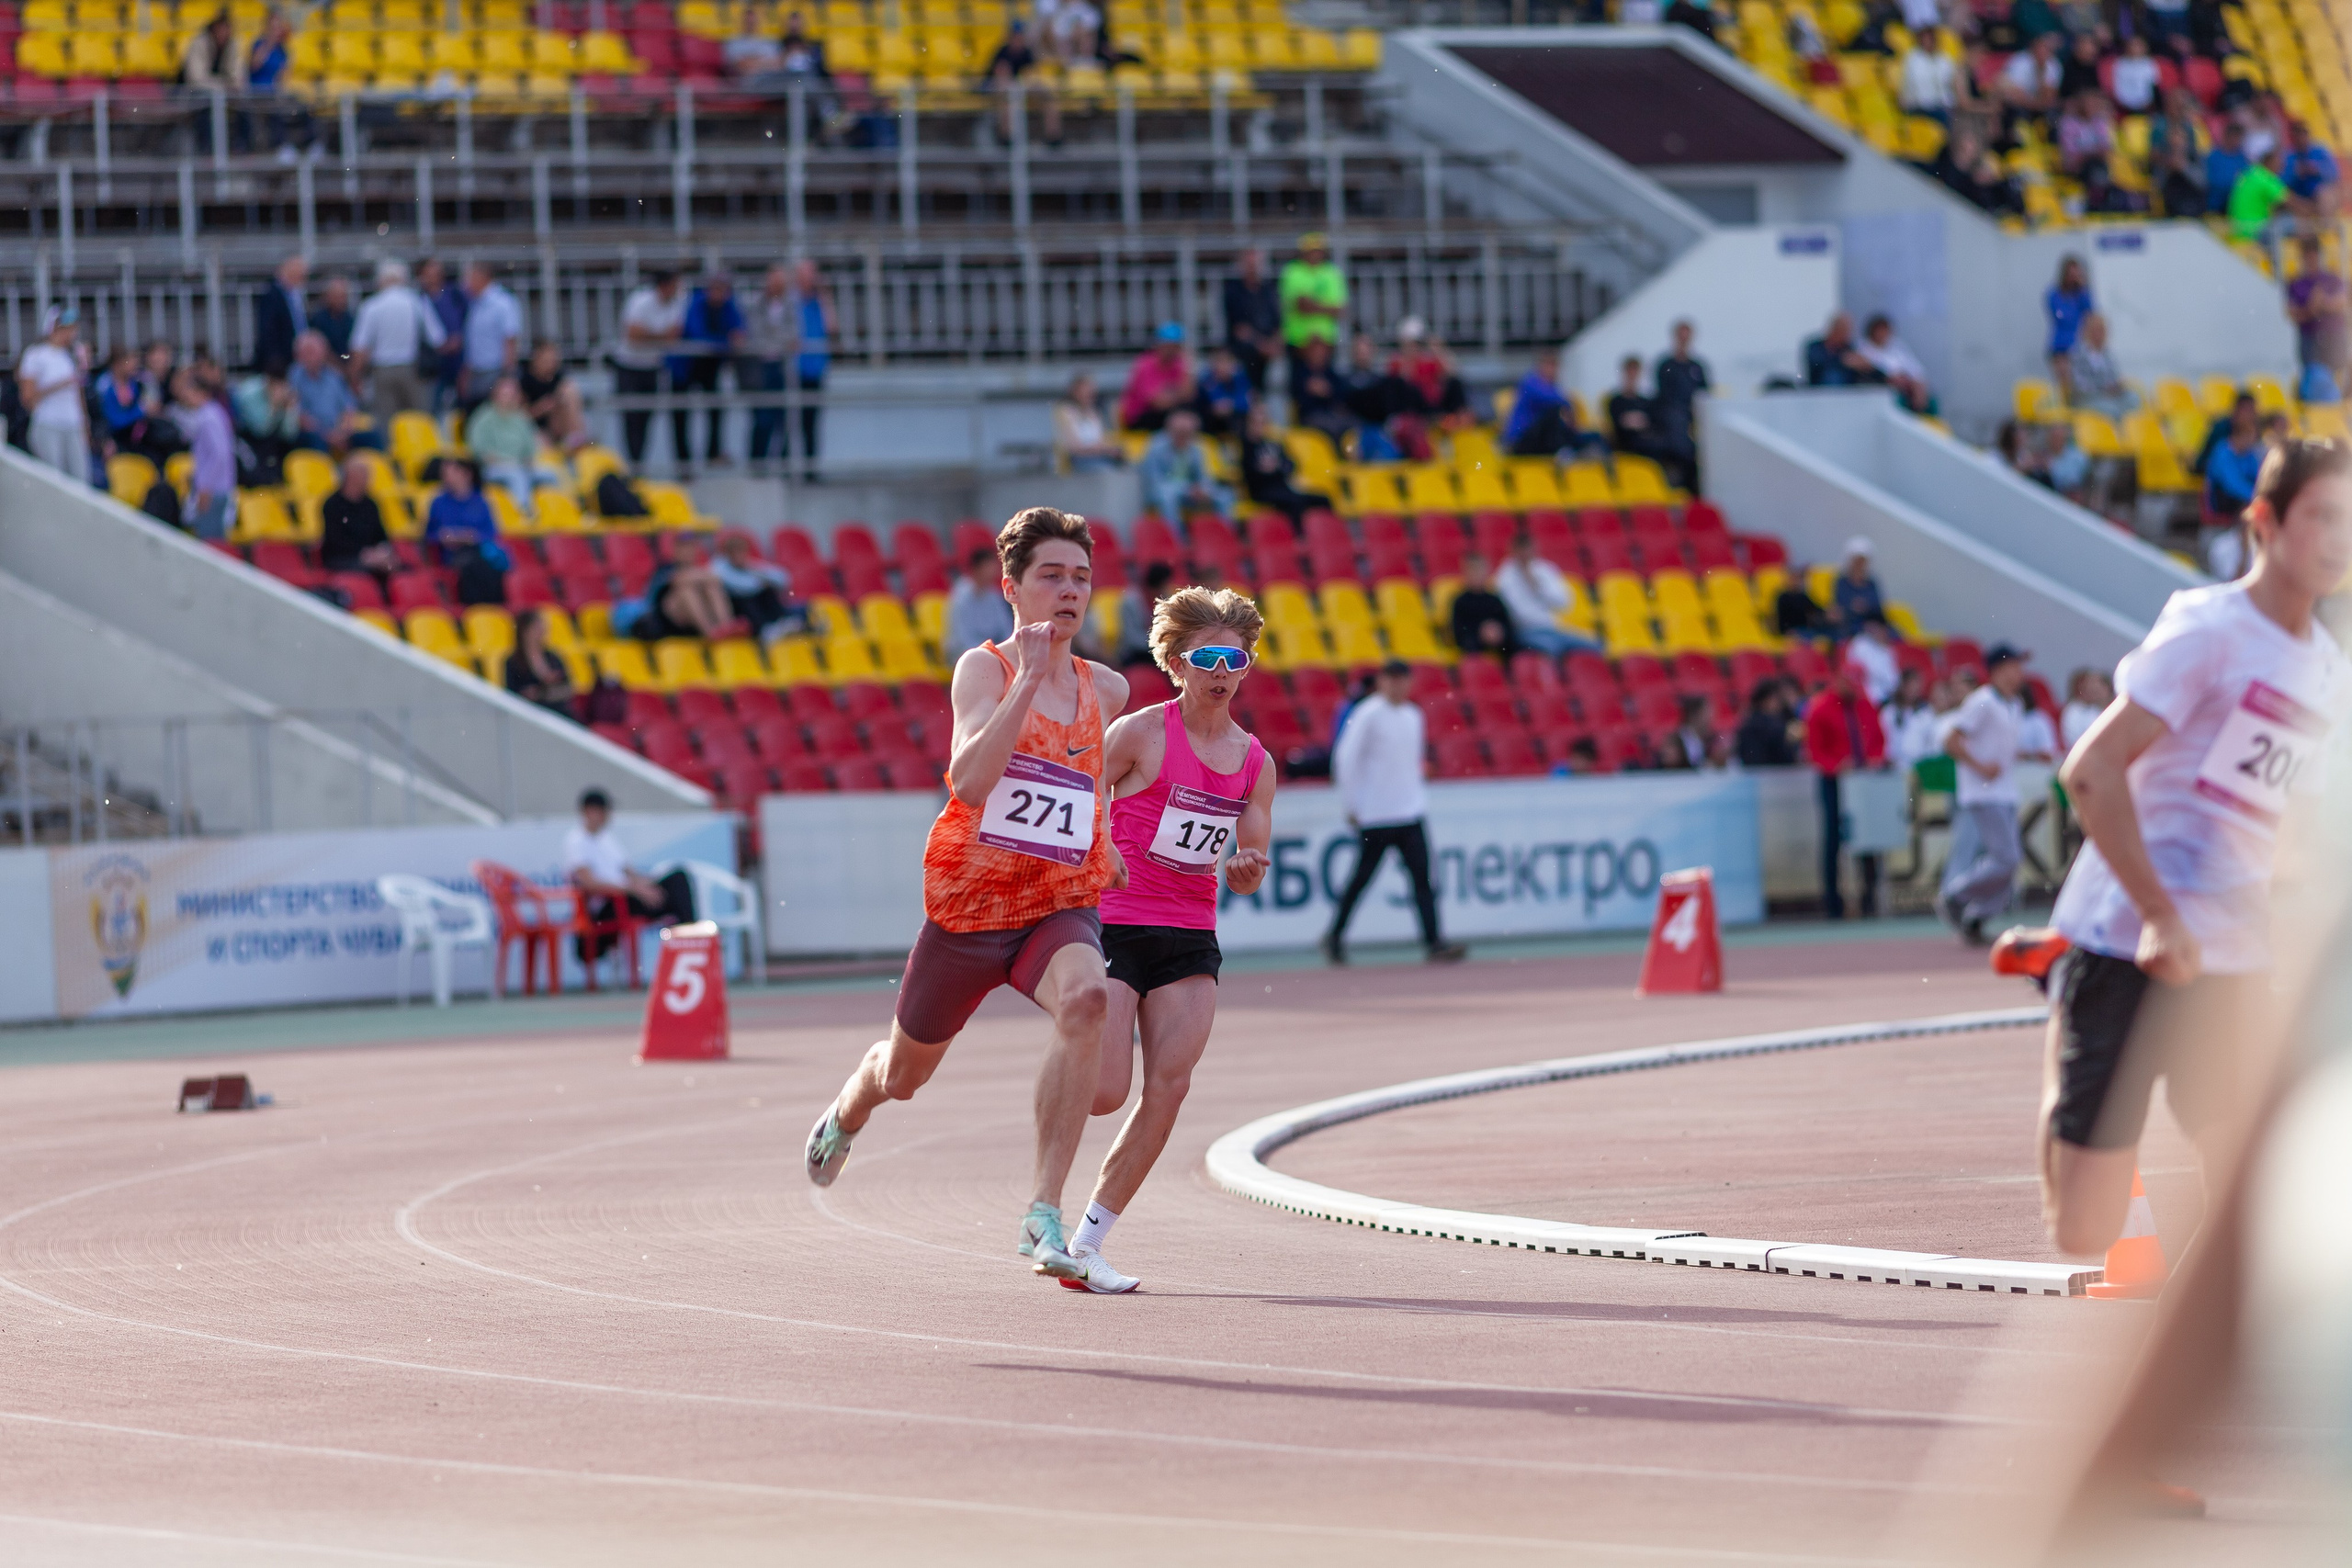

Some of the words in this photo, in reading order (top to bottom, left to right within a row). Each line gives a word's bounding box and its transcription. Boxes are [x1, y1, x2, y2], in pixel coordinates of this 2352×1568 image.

[1005, 789, 1074, 837] 271
[1176, 796, 1204, 807] ПРИВОЛЖСКОГО
[1177, 791, 1206, 803] ЧЕМПИОНАТ
[1175, 819, 1229, 855] 178
[175, 880, 389, 919] МИНИСТЕРСТВО
[1660, 896, 1700, 953] 4
[231, 927, 331, 964] СПОРТА
[663, 952, 708, 1014] 5
